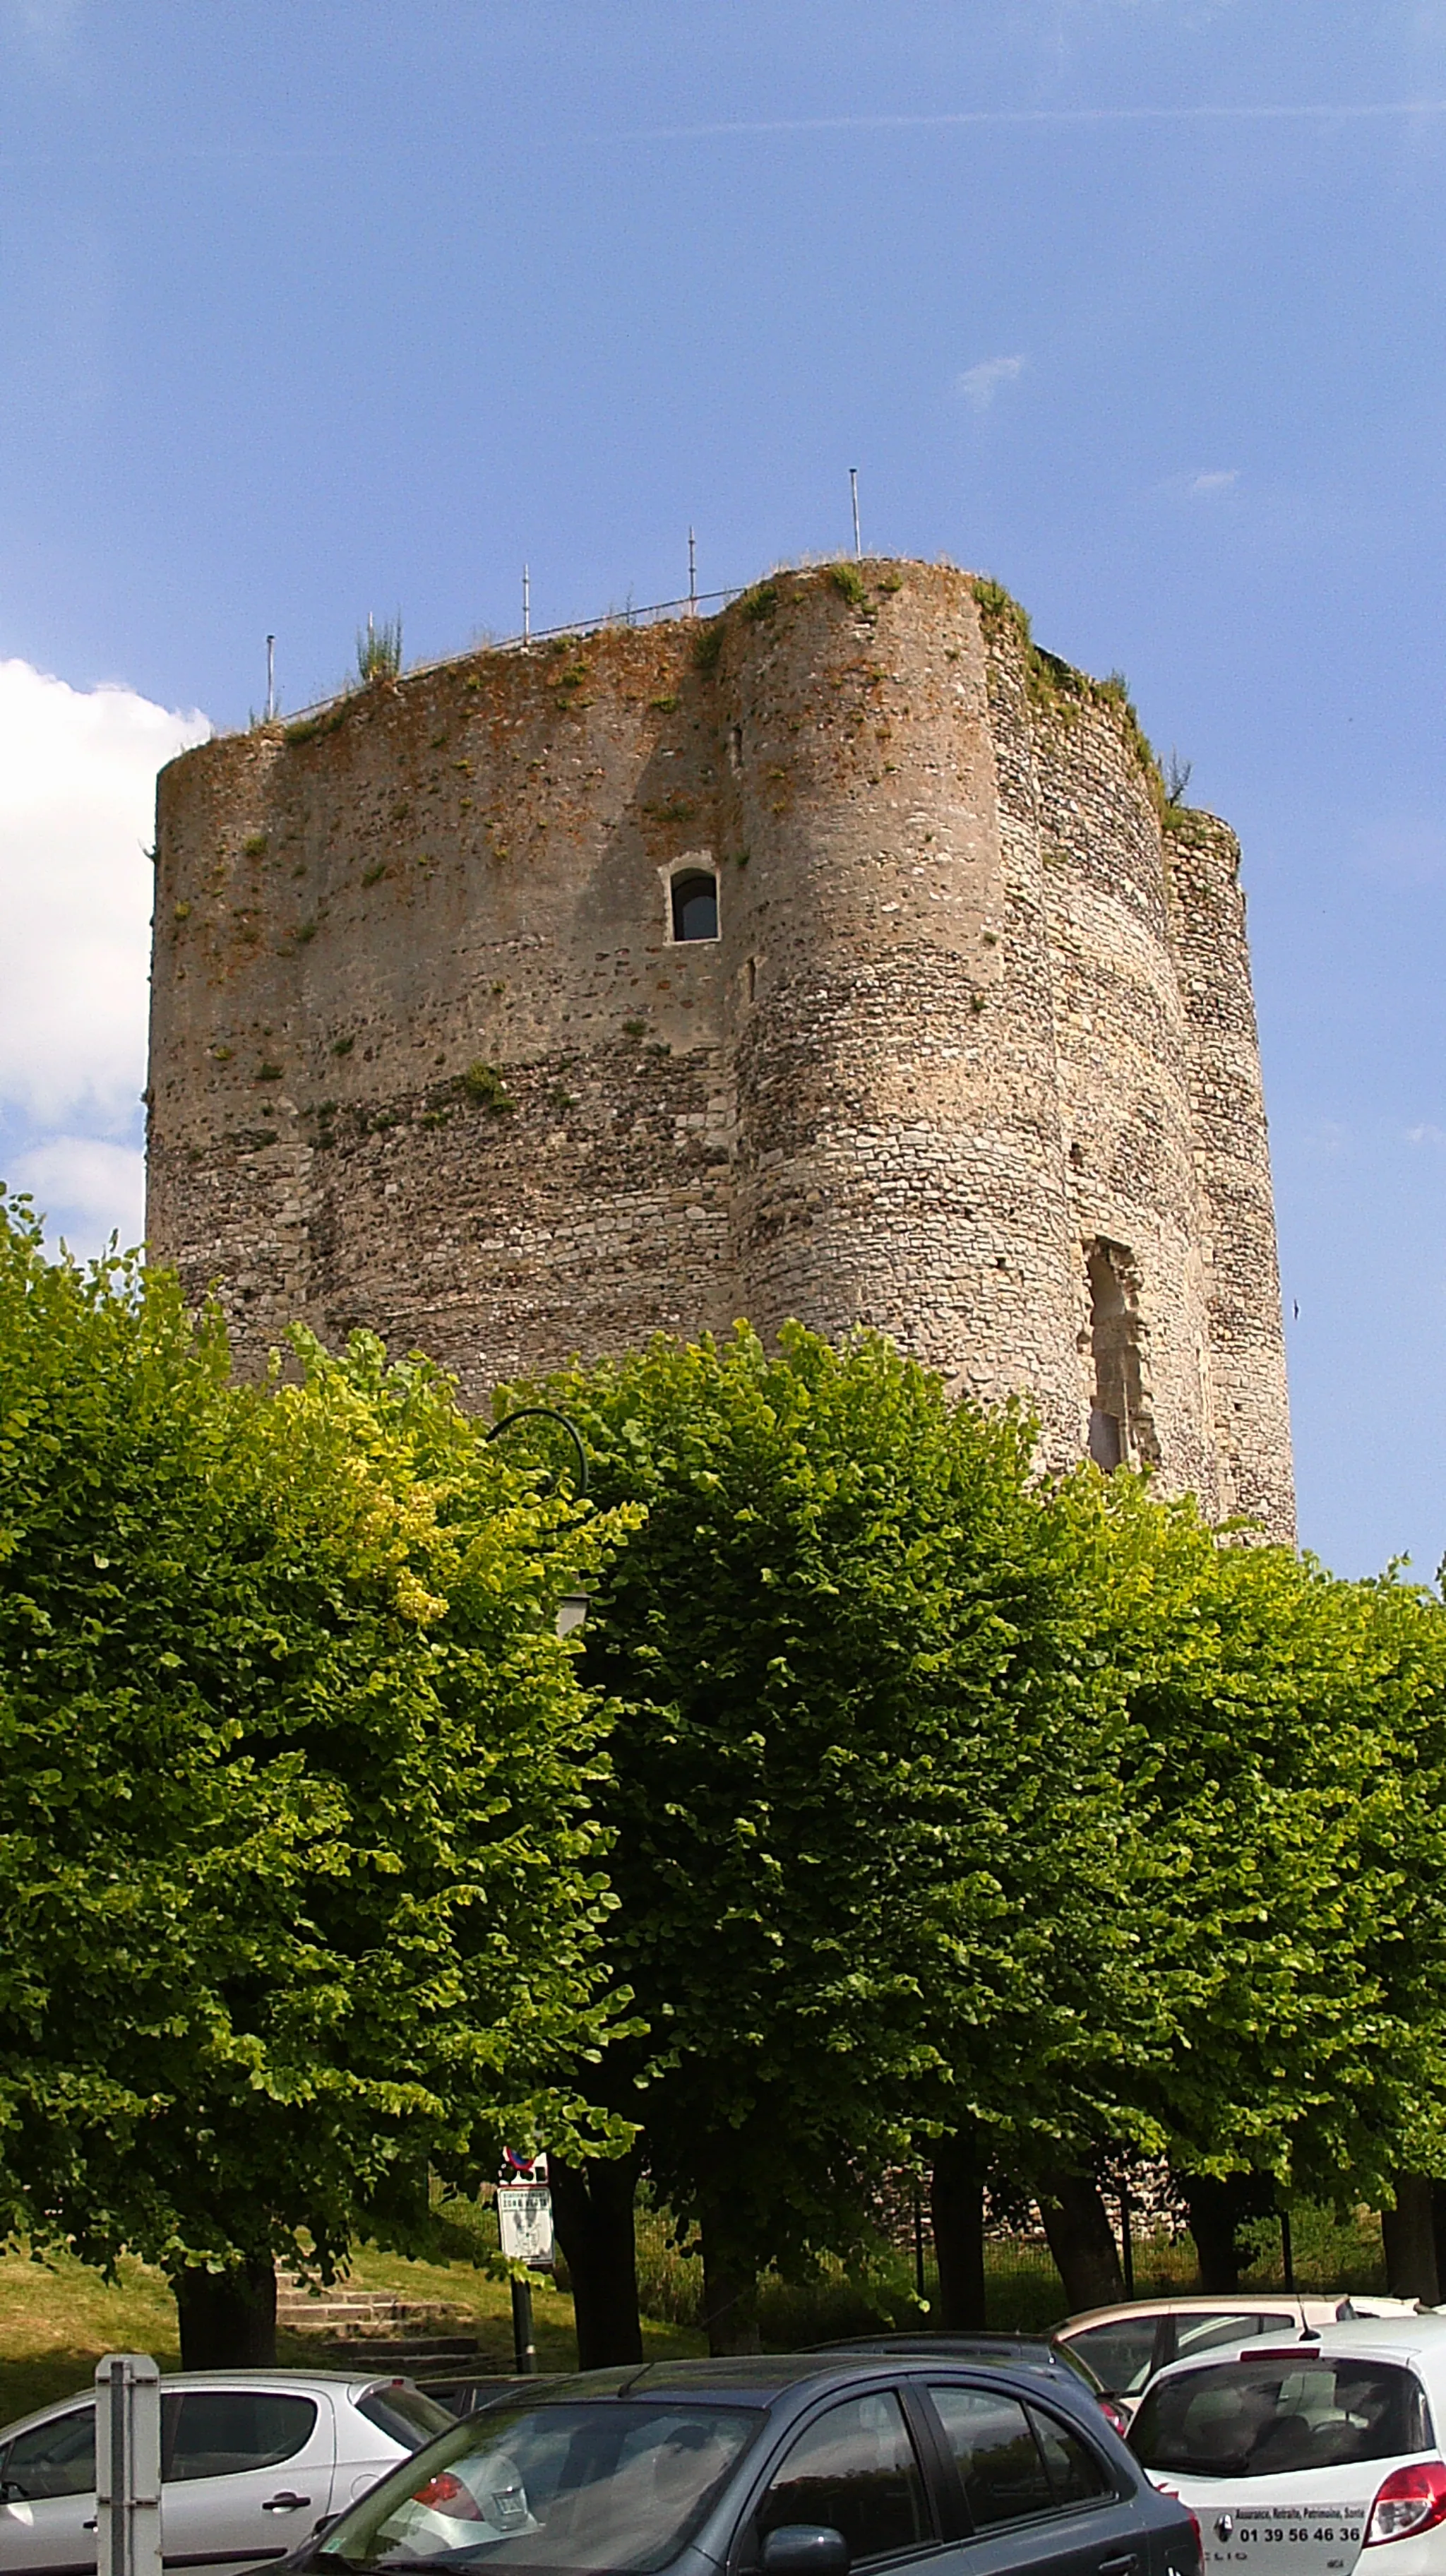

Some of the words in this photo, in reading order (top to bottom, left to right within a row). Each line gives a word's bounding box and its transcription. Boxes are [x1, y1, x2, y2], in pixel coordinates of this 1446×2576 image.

[1236, 2508, 1271, 2520] Assurance,
[1273, 2508, 1301, 2521] Retraite,
[1303, 2508, 1342, 2521] Patrimoine,
[1240, 2529, 1257, 2542] 01
[1265, 2529, 1284, 2542] 39
[1289, 2529, 1308, 2541] 56
[1313, 2529, 1334, 2541] 46
[1339, 2528, 1360, 2541] 36
